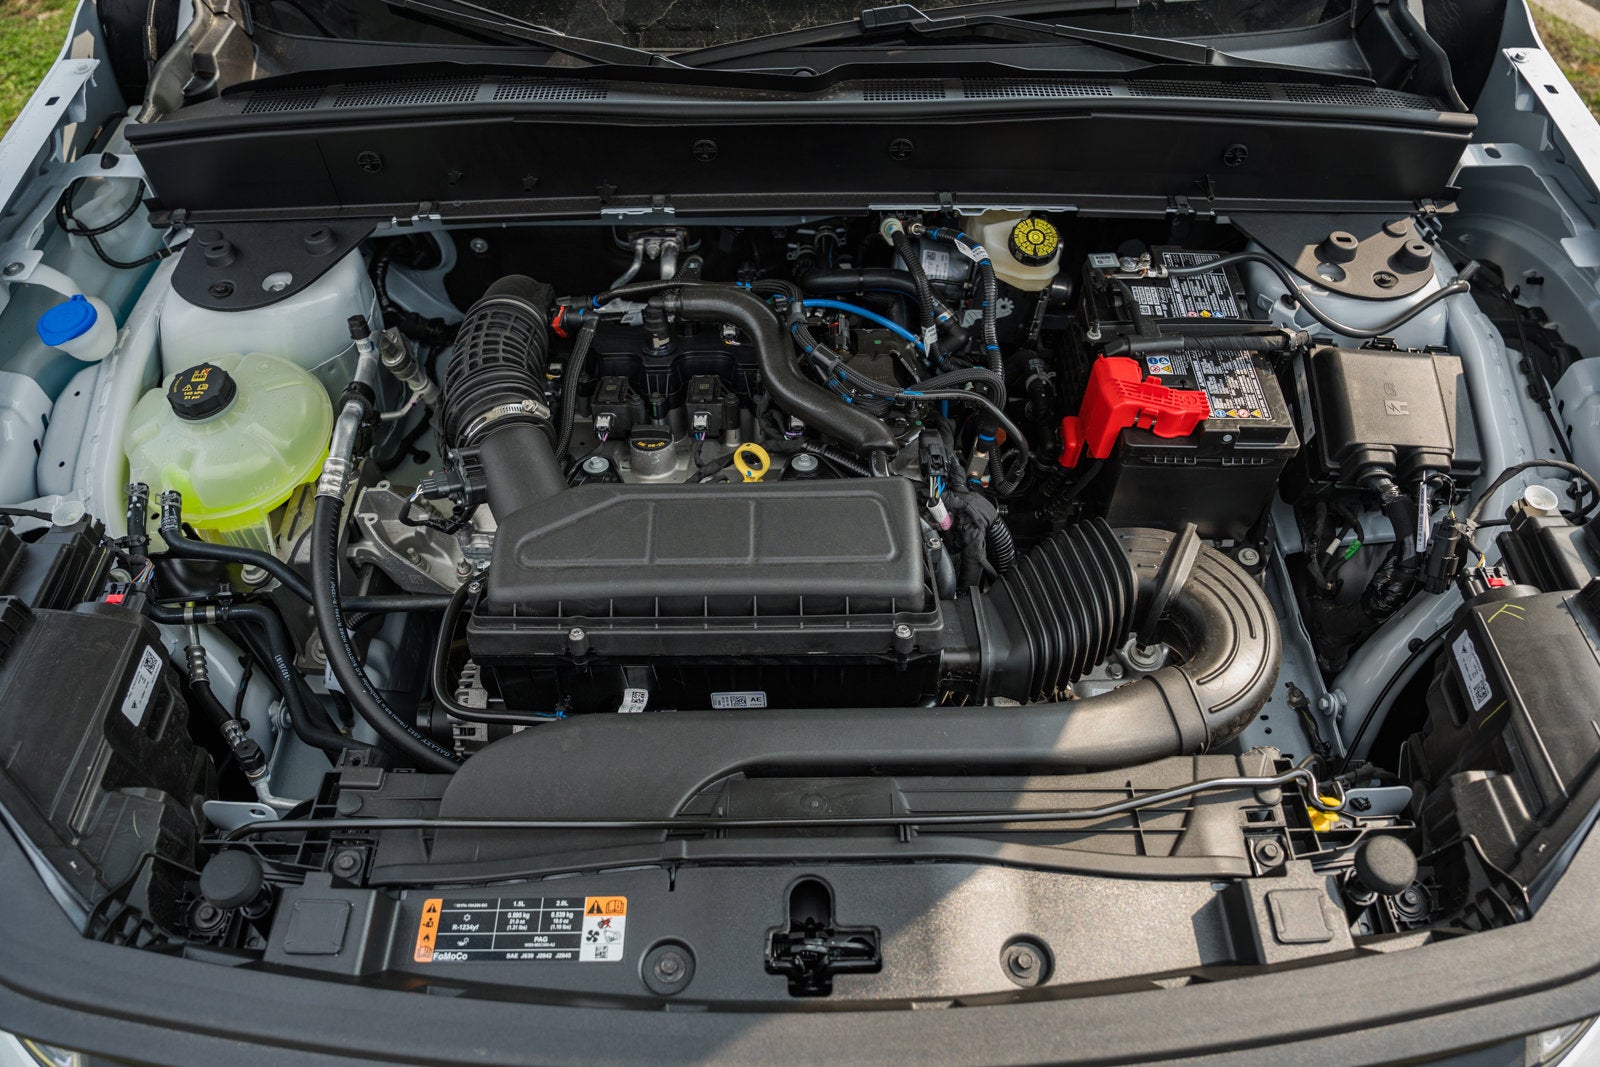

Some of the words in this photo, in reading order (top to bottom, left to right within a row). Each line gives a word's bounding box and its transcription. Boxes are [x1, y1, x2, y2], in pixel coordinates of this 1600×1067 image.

[339, 627, 348, 643] HOSE
[344, 643, 358, 666] SUCTION
[420, 738, 451, 757] GALAXY
[433, 952, 468, 960] FoMoCo
